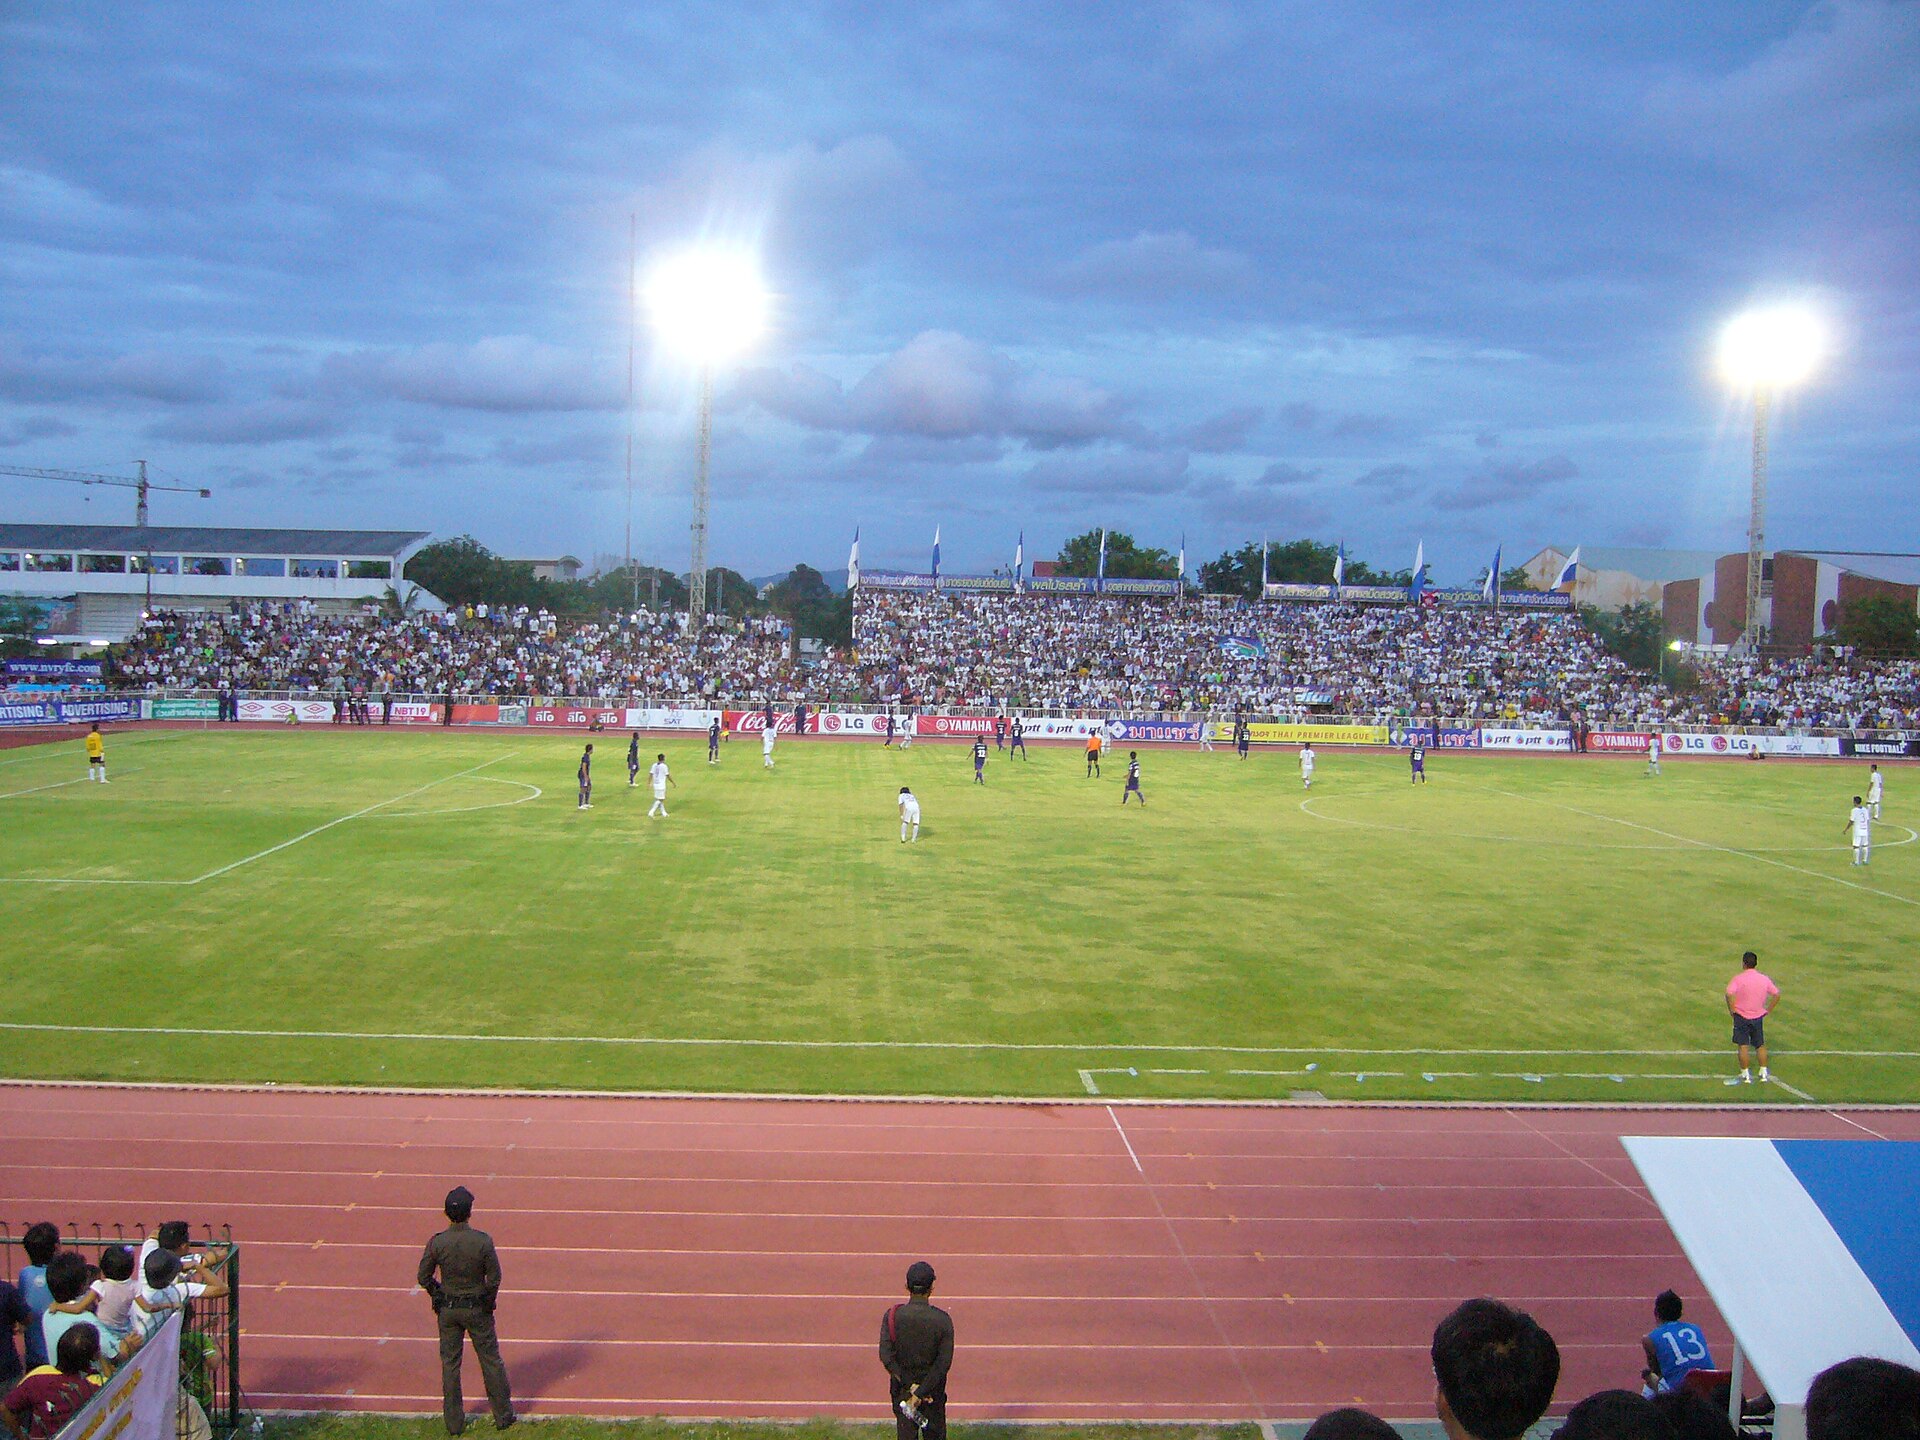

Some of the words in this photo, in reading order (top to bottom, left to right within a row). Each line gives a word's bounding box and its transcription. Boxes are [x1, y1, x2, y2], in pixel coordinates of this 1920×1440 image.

[0, 705, 44, 719] RTISING
[61, 702, 129, 716] ADVERTISING
[394, 707, 414, 715] NBT
[416, 707, 427, 715] 19
[845, 718, 864, 729] LG
[949, 720, 992, 732] YAMAHA
[1024, 724, 1041, 733] ptt
[1056, 725, 1074, 734] ptt
[1297, 731, 1335, 739] PREMIER
[1494, 736, 1511, 744] ptt
[1525, 736, 1542, 745] ptt
[1604, 735, 1646, 747] YAMAHA
[1686, 738, 1704, 749] LG
[1731, 739, 1748, 750] LG
[1871, 744, 1905, 754] FOOTBALL
[1662, 1327, 1706, 1366] 13
